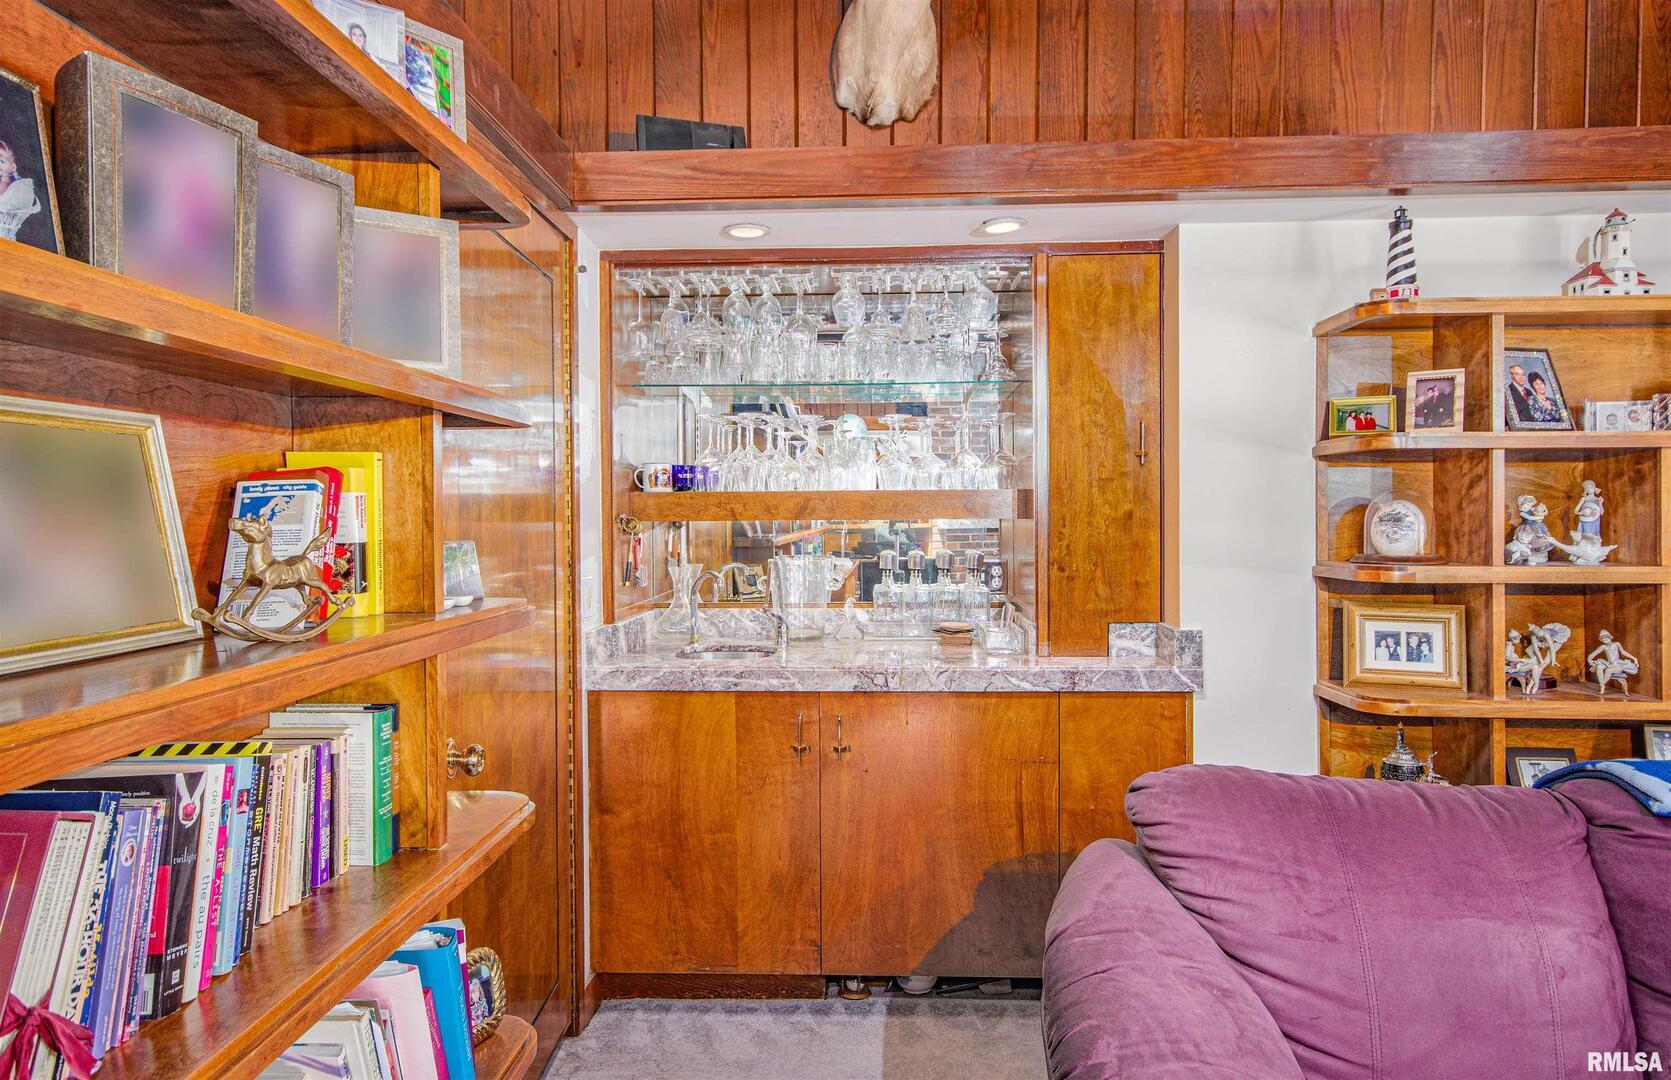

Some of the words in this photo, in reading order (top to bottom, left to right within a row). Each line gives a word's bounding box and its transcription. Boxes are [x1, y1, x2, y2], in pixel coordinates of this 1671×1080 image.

[210, 789, 219, 805] de
[209, 807, 216, 818] la
[206, 820, 215, 847] cruz
[173, 845, 198, 865] twilight
[216, 844, 224, 869] THE
[250, 835, 260, 865] Math
[238, 809, 253, 922] STORMBREAKER
[200, 874, 210, 898] the
[246, 867, 257, 911] Review
[197, 905, 205, 924] au
[209, 878, 220, 927] A-LIST
[72, 894, 101, 989] 36-HOUR
[166, 948, 188, 961] MEYER
[190, 929, 203, 970] pairs
